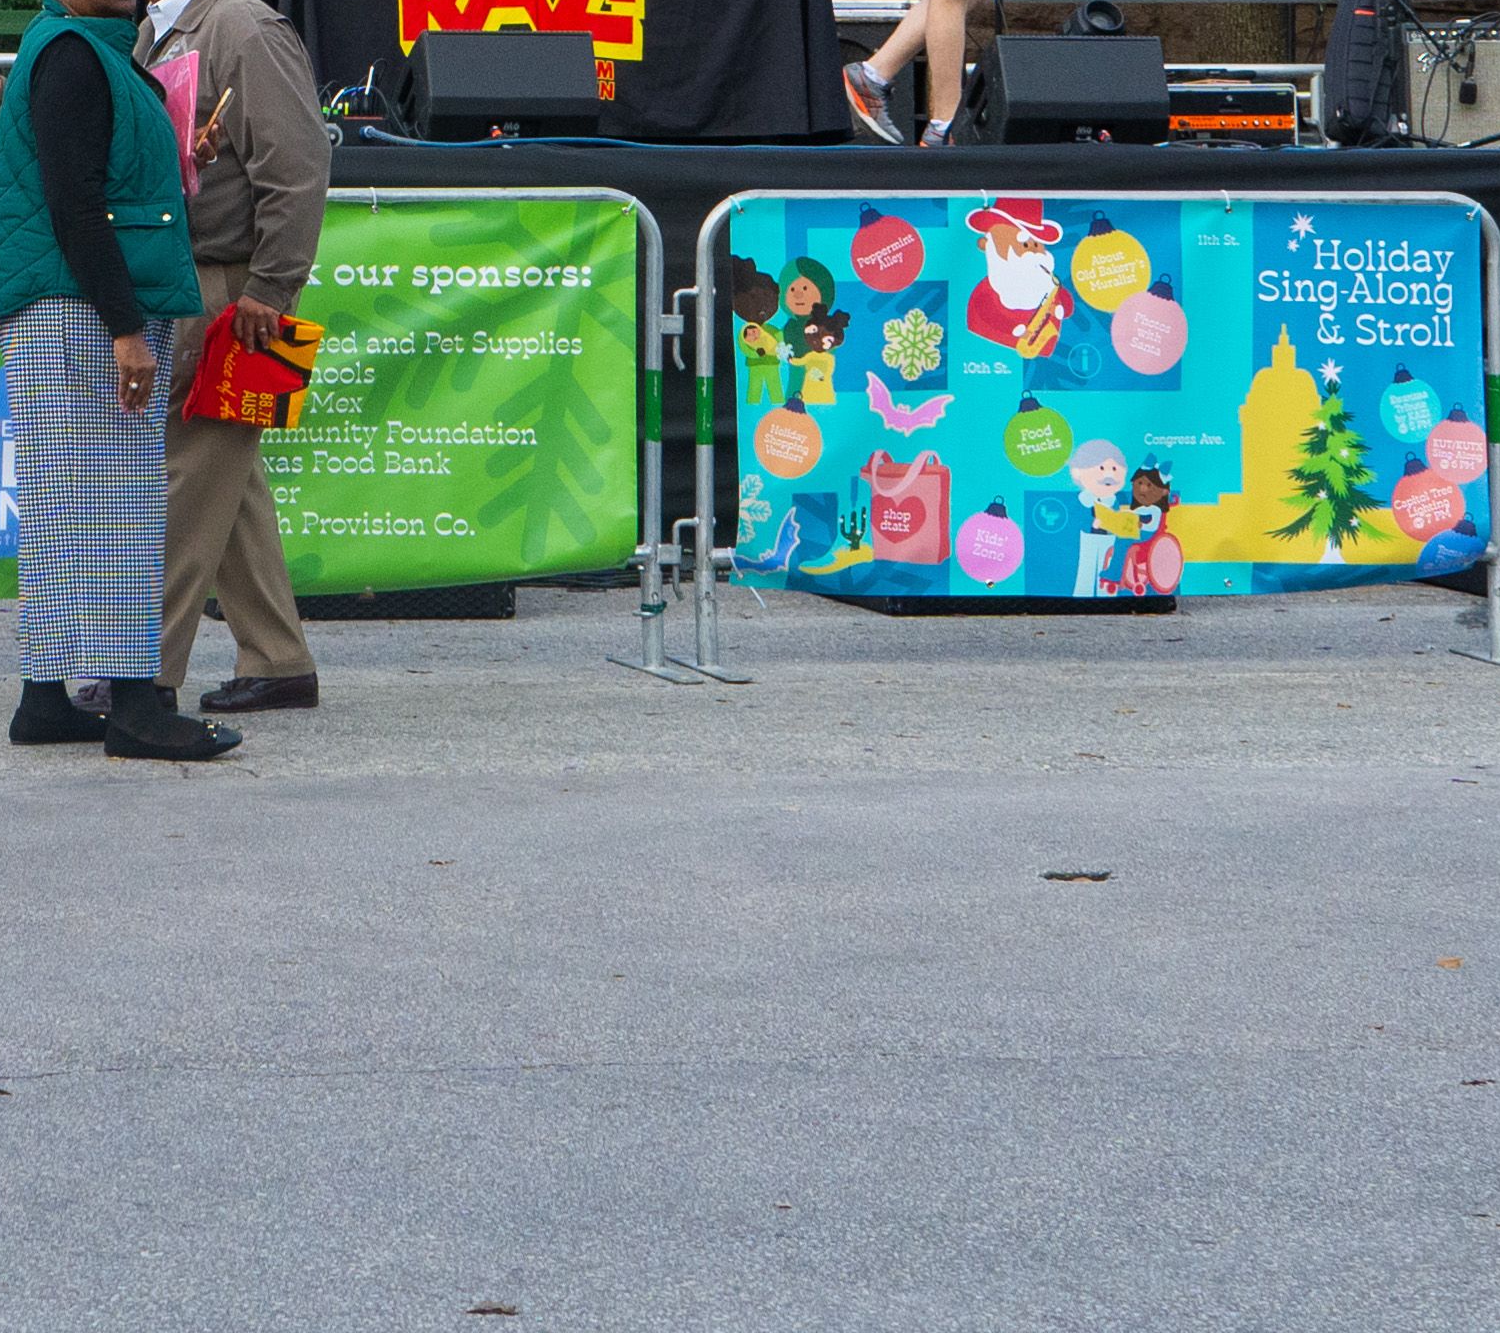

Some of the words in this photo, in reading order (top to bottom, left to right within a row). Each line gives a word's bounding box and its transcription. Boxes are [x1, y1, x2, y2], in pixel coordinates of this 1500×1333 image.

[1198, 234, 1220, 246] 11th
[1223, 234, 1240, 246] St.
[856, 233, 915, 269] Peppermint
[879, 251, 903, 271] Alley
[1091, 251, 1125, 265] About
[1313, 239, 1455, 282] Holiday
[334, 264, 399, 287] our
[412, 264, 592, 294] sponsors:
[1076, 269, 1097, 282] Old
[1090, 274, 1137, 292] Muralist
[1258, 270, 1453, 314] Sing-Along
[1134, 312, 1172, 333] Photos
[1317, 313, 1345, 344] &
[1356, 313, 1455, 347] Stroll
[317, 331, 358, 354] eed
[366, 331, 416, 355] and
[423, 331, 464, 354] Pet
[471, 331, 583, 360] Supplies
[962, 362, 990, 374] 10th
[993, 362, 1012, 375] St.
[241, 390, 258, 423] AUST
[258, 392, 275, 426] 88.7F
[259, 420, 378, 449] mmunity
[386, 420, 538, 445] Foundation
[770, 424, 808, 443] Holiday
[1020, 424, 1053, 442] Food
[1144, 433, 1197, 448] Congress
[1199, 433, 1226, 445] Ave.
[764, 433, 809, 456] Shopping
[764, 444, 804, 463] Vendors
[1017, 438, 1062, 456] Trucks
[262, 454, 303, 474] xas
[312, 451, 376, 474] Food
[384, 451, 451, 474] Bank
[1393, 491, 1430, 511] Capitol
[1429, 485, 1453, 500] Tree
[1407, 498, 1451, 518] Lighting
[302, 511, 426, 536] Provision
[434, 512, 476, 536] Co.
[883, 508, 911, 522] shop
[975, 528, 1008, 547] Kids'
[972, 544, 1005, 562] Zone
